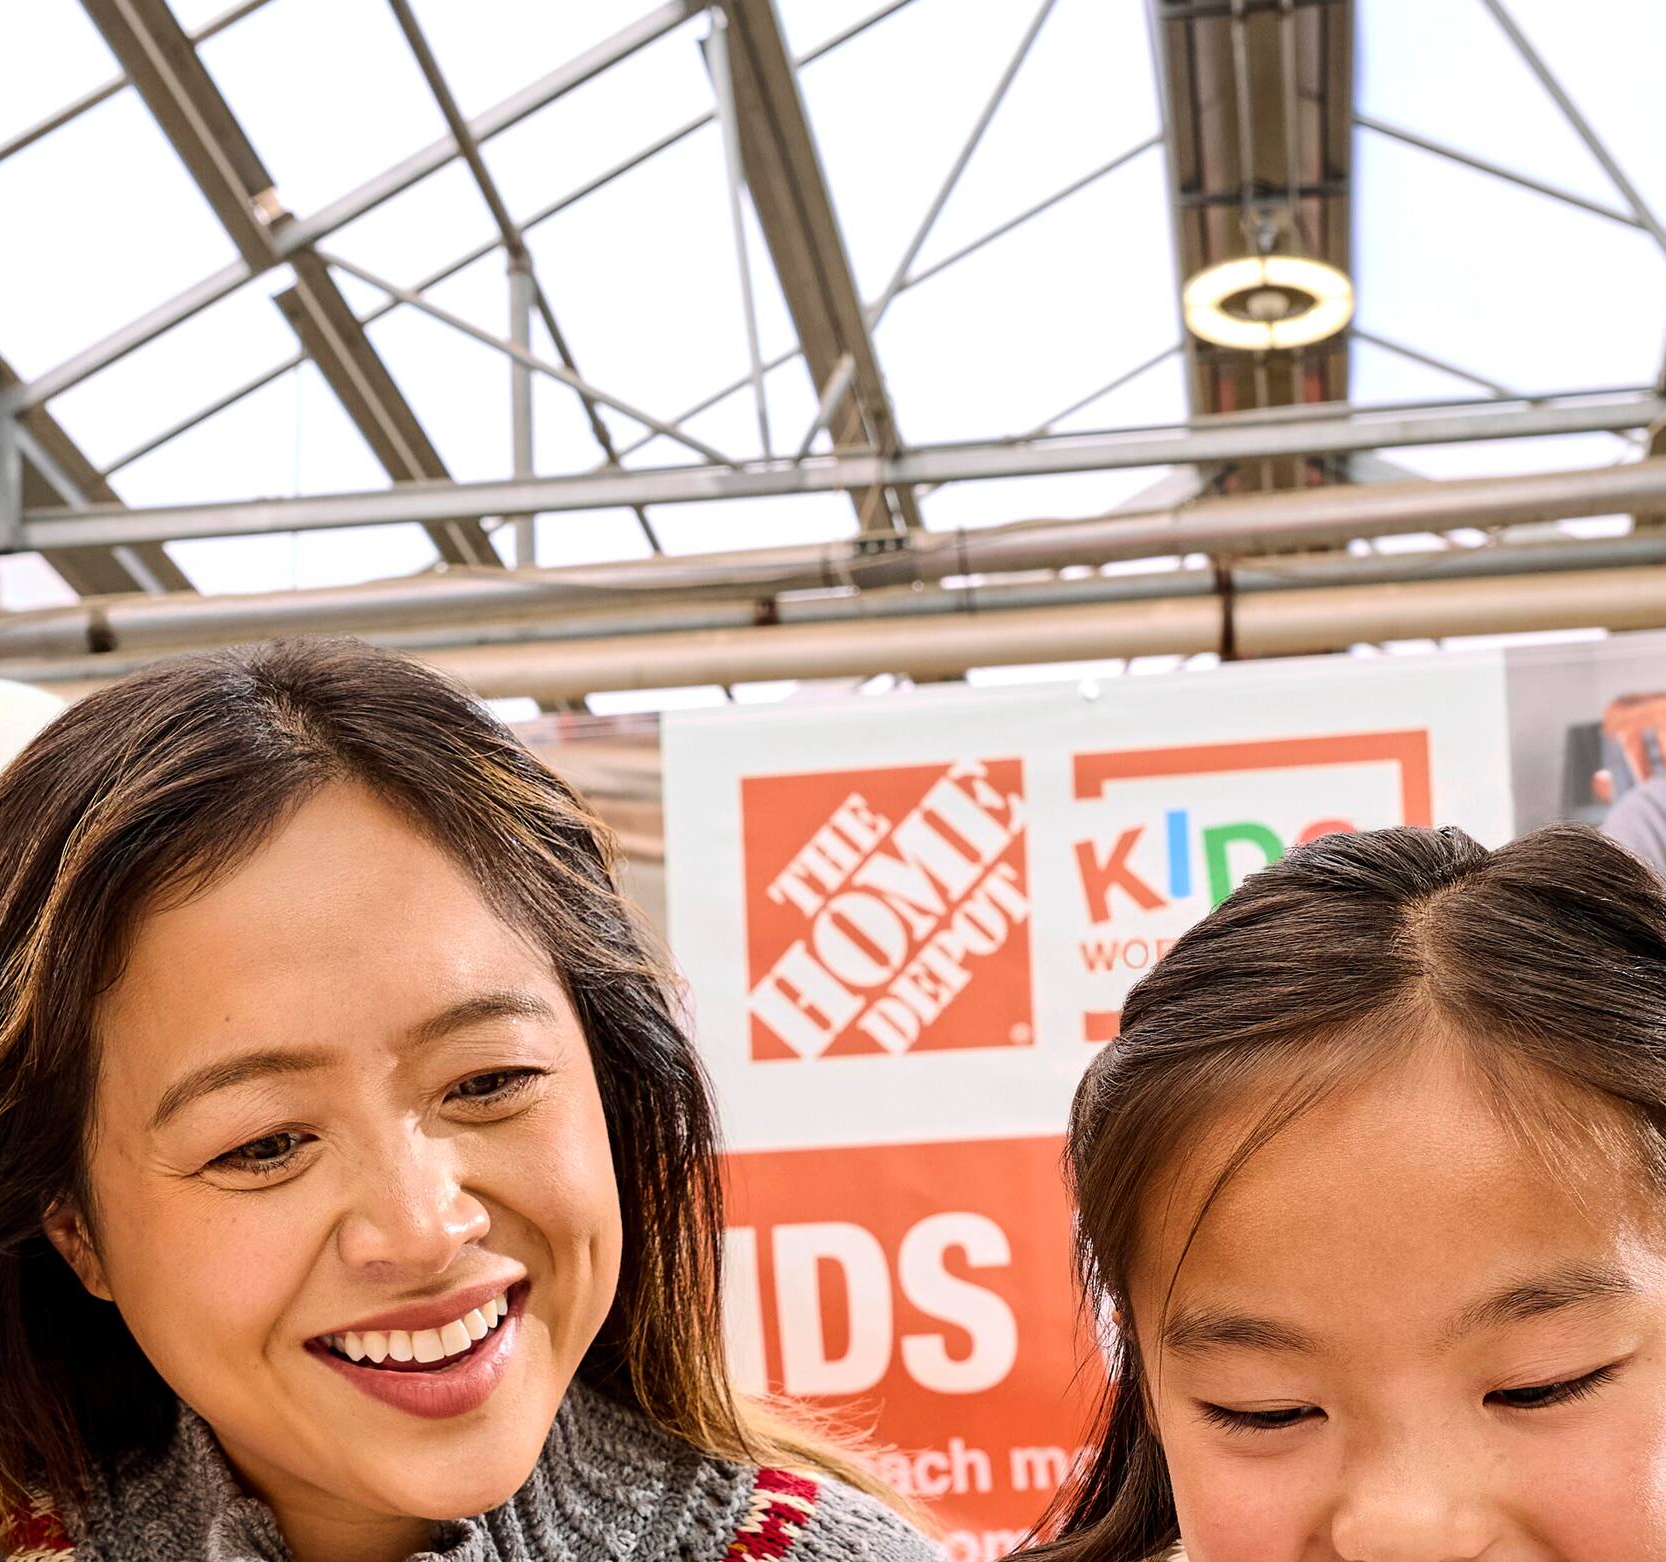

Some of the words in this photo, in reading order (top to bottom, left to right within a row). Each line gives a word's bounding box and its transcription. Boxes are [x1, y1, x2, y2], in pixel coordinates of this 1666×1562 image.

[746, 759, 1027, 1060] HOME
[767, 792, 893, 923] THE
[1074, 808, 1356, 925] KID
[857, 861, 1034, 1054] DEPOT
[722, 1211, 1019, 1396] IDS
